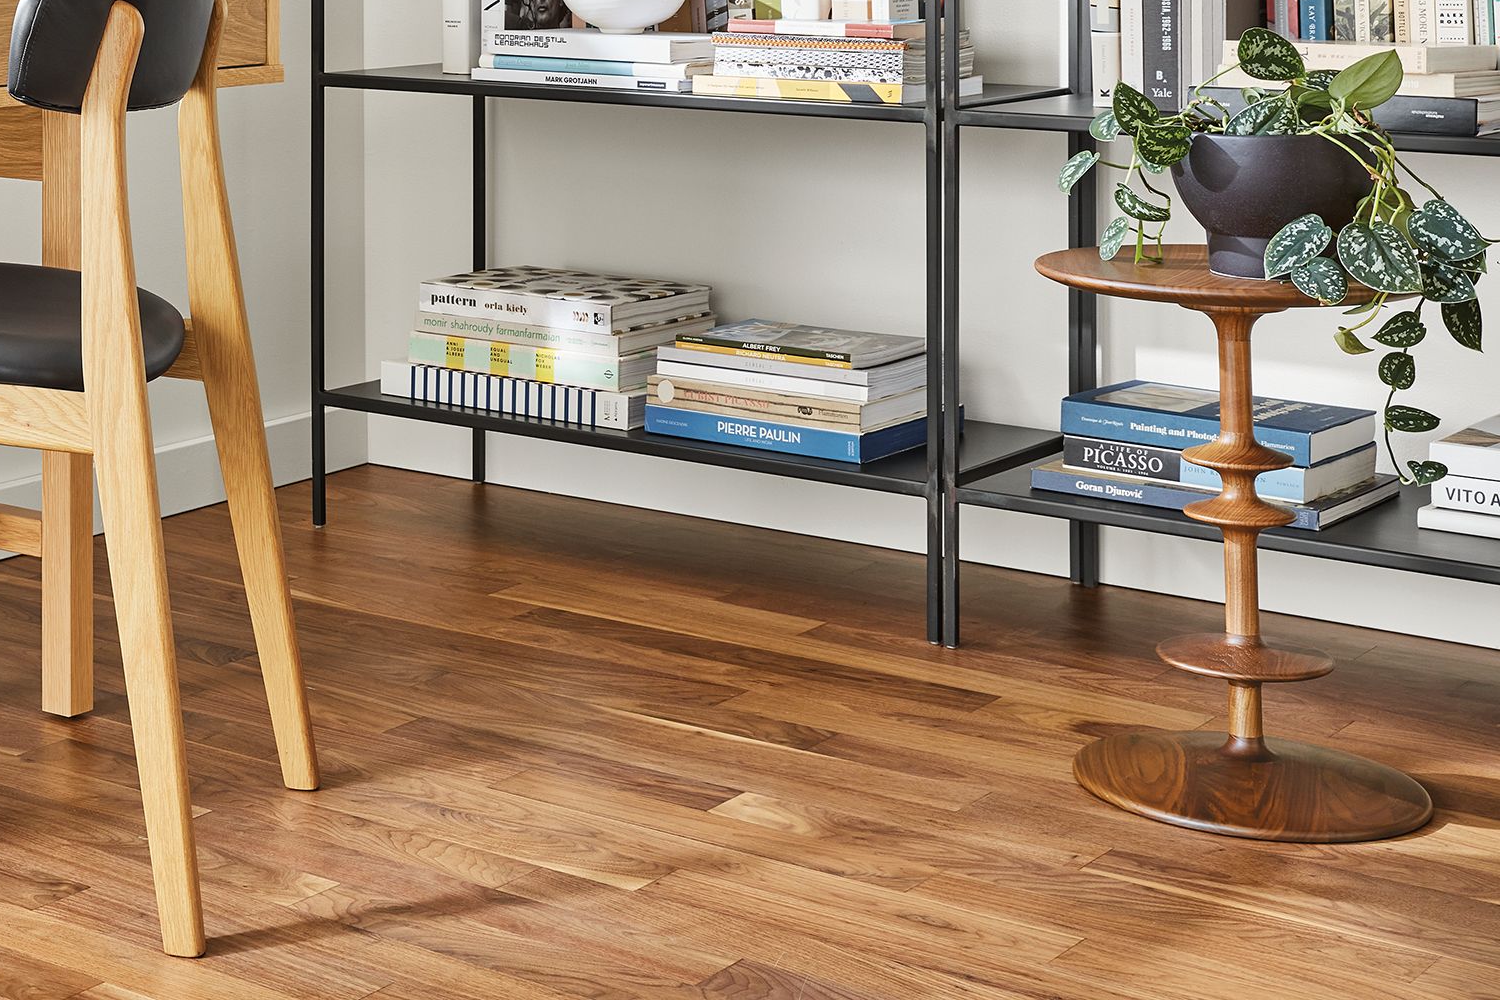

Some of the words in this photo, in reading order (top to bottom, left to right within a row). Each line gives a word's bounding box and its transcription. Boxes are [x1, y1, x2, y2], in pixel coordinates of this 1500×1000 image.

[1398, 12, 1406, 36] BOTTLES
[1418, 8, 1428, 36] MORE
[494, 34, 532, 42] MONDRIAN
[545, 36, 567, 44] STIJL
[1162, 16, 1172, 51] 1962-1966
[545, 76, 562, 84] MARK
[1152, 88, 1172, 98] Yale
[430, 292, 477, 308] pattern
[484, 302, 503, 311] orla
[506, 304, 528, 316] kiely
[423, 317, 448, 328] monir
[450, 318, 494, 334] shahroudy
[496, 322, 560, 342] farmanfarmaian
[490, 346, 506, 354] EQUAL
[742, 342, 764, 351] ALBERT
[736, 350, 762, 359] RICHARD
[762, 352, 786, 362] NEUTRA
[826, 352, 844, 360] TASCHEN
[684, 389, 722, 402] CUBIST
[725, 394, 770, 408] PICASSO
[717, 421, 758, 437] PIERRE
[760, 426, 800, 443] PAULIN
[1130, 422, 1166, 436] Painting
[1168, 427, 1184, 437] and
[1110, 444, 1132, 452] LIFE
[1136, 448, 1148, 456] OF
[1260, 439, 1295, 451] Flammarion
[1083, 446, 1163, 473] PICASSO
[1184, 464, 1206, 475] JOHN
[1076, 480, 1104, 494] Goran
[1106, 484, 1143, 500] Djurović
[1445, 487, 1486, 505] VITO
[1490, 493, 1500, 507] A
